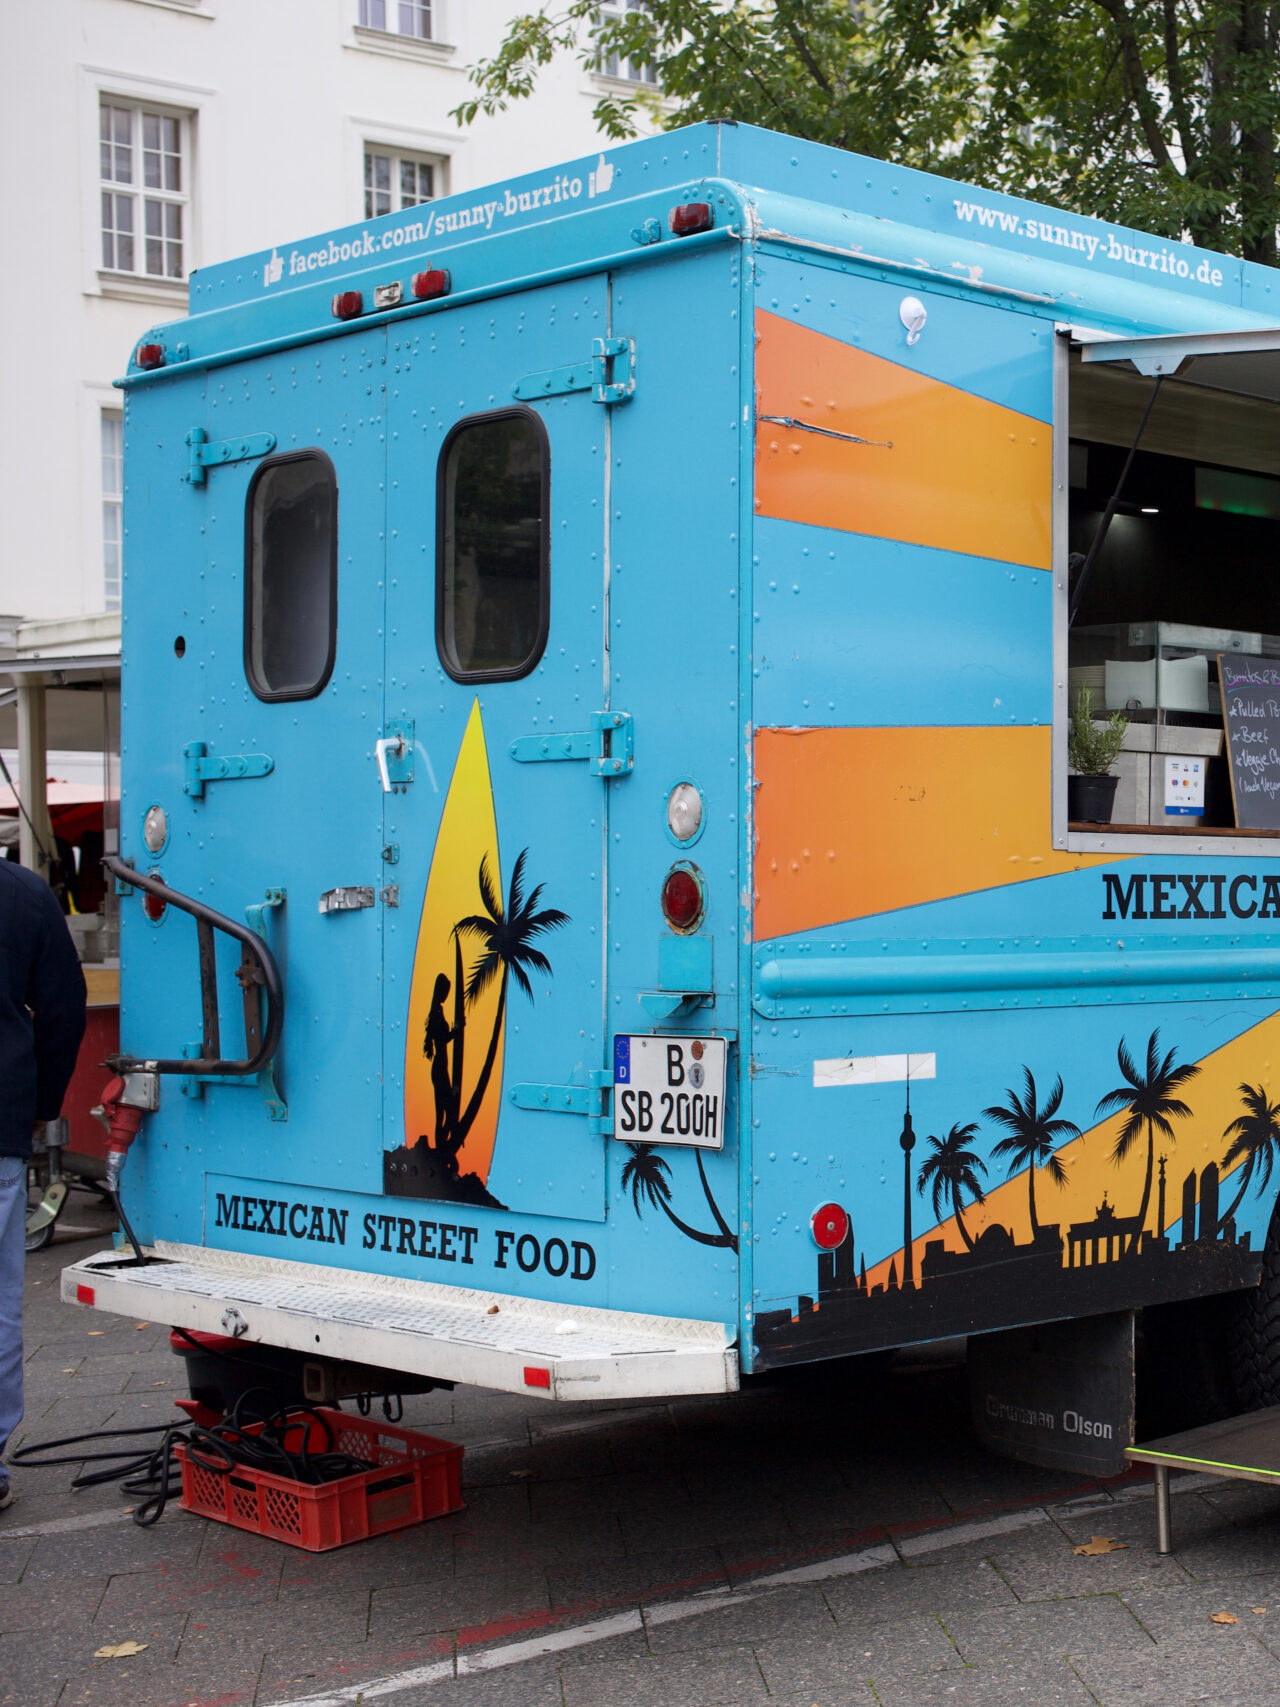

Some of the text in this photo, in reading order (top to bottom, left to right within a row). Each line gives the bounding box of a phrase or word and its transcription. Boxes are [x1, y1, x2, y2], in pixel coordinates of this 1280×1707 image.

[289, 177, 582, 275] facebook.com/sunny-burrito
[953, 200, 1223, 287] www.sunny-burrito.de
[1234, 697, 1266, 718] Pulled
[1240, 726, 1269, 744] Beef
[1241, 748, 1270, 776] Veggie
[620, 1044, 685, 1086] D B
[621, 1090, 718, 1138] SB 200H
[215, 1193, 596, 1281] MEXICAN STREET FOOD
[1063, 1410, 1112, 1439] Olson
